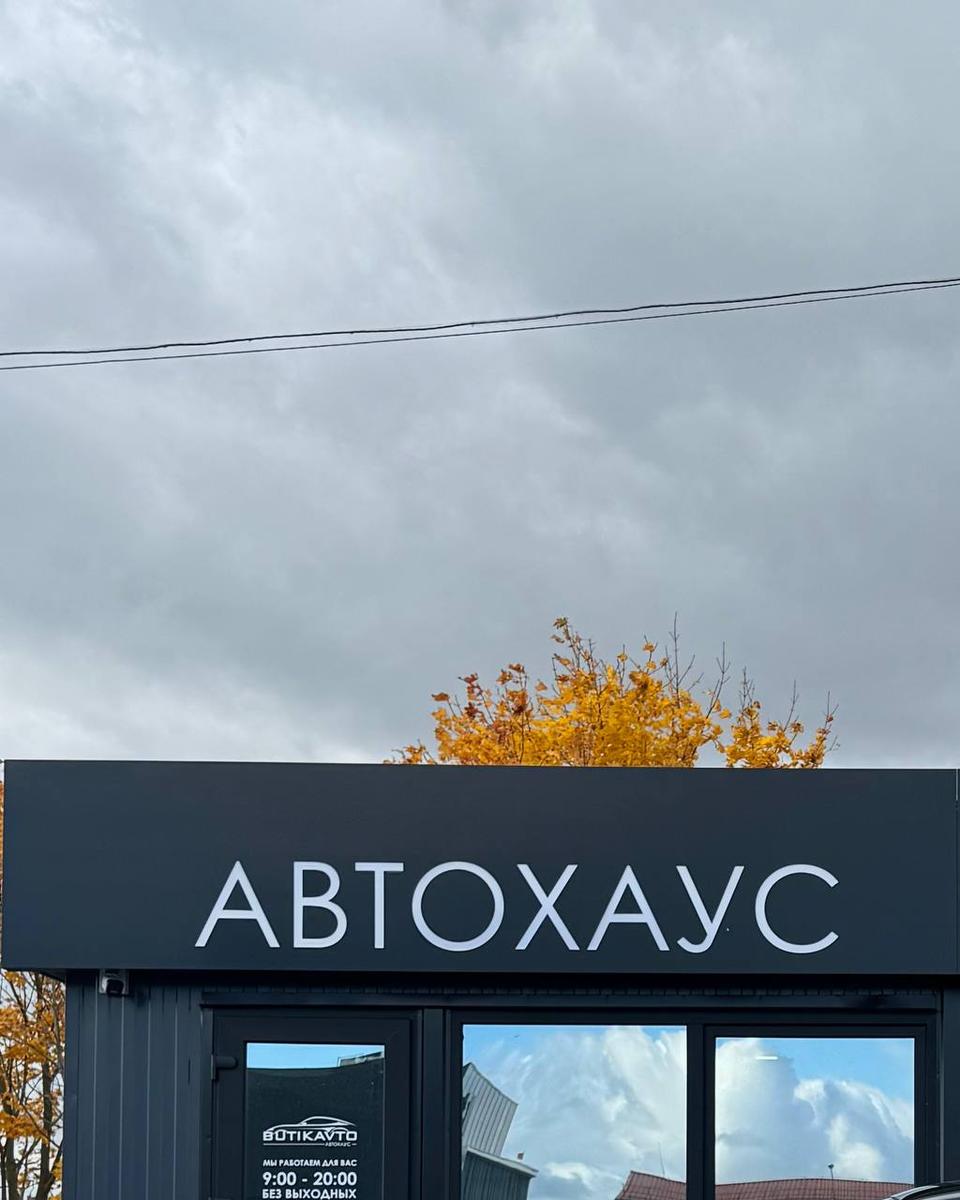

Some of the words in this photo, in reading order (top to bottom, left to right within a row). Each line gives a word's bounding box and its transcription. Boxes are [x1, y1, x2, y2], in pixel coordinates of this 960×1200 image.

[195, 861, 839, 955] АВТОХАУС
[262, 1131, 358, 1141] BUTIKAVTO
[262, 1159, 277, 1167] МЫ
[279, 1159, 320, 1167] РАБОТАЕМ
[321, 1159, 339, 1168] ДЛЯ
[340, 1159, 357, 1167] ВАС
[262, 1171, 297, 1186] 9:00
[313, 1171, 357, 1186] 20:00
[262, 1188, 282, 1199] БЕЗ
[285, 1188, 357, 1200] ВЫХОДНЫХ
